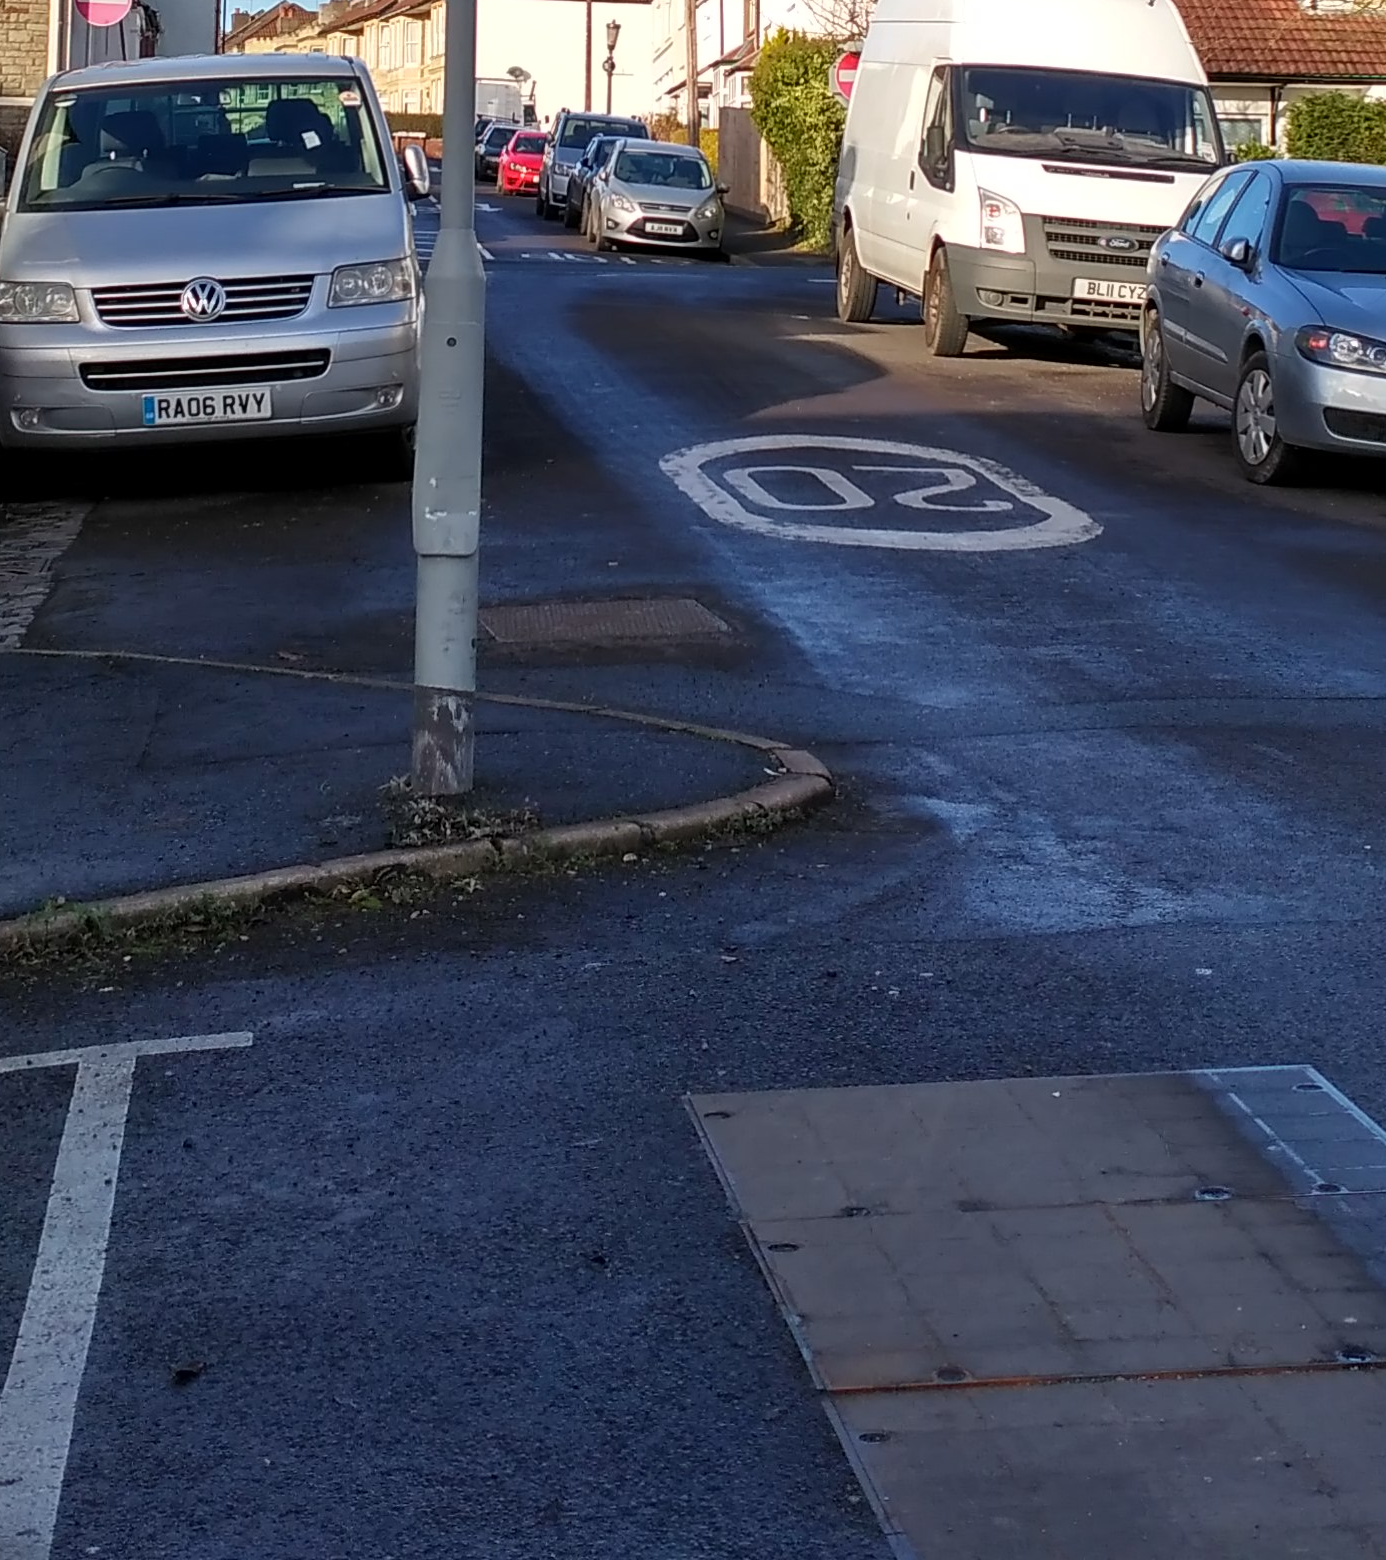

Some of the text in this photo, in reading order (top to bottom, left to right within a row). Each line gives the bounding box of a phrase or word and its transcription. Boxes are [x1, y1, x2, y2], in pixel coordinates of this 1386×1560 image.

[1109, 239, 1130, 249] Ford
[1086, 282, 1147, 300] BL11 CYZ
[158, 392, 265, 419] RA06 RVY
[722, 466, 1014, 511] 20
